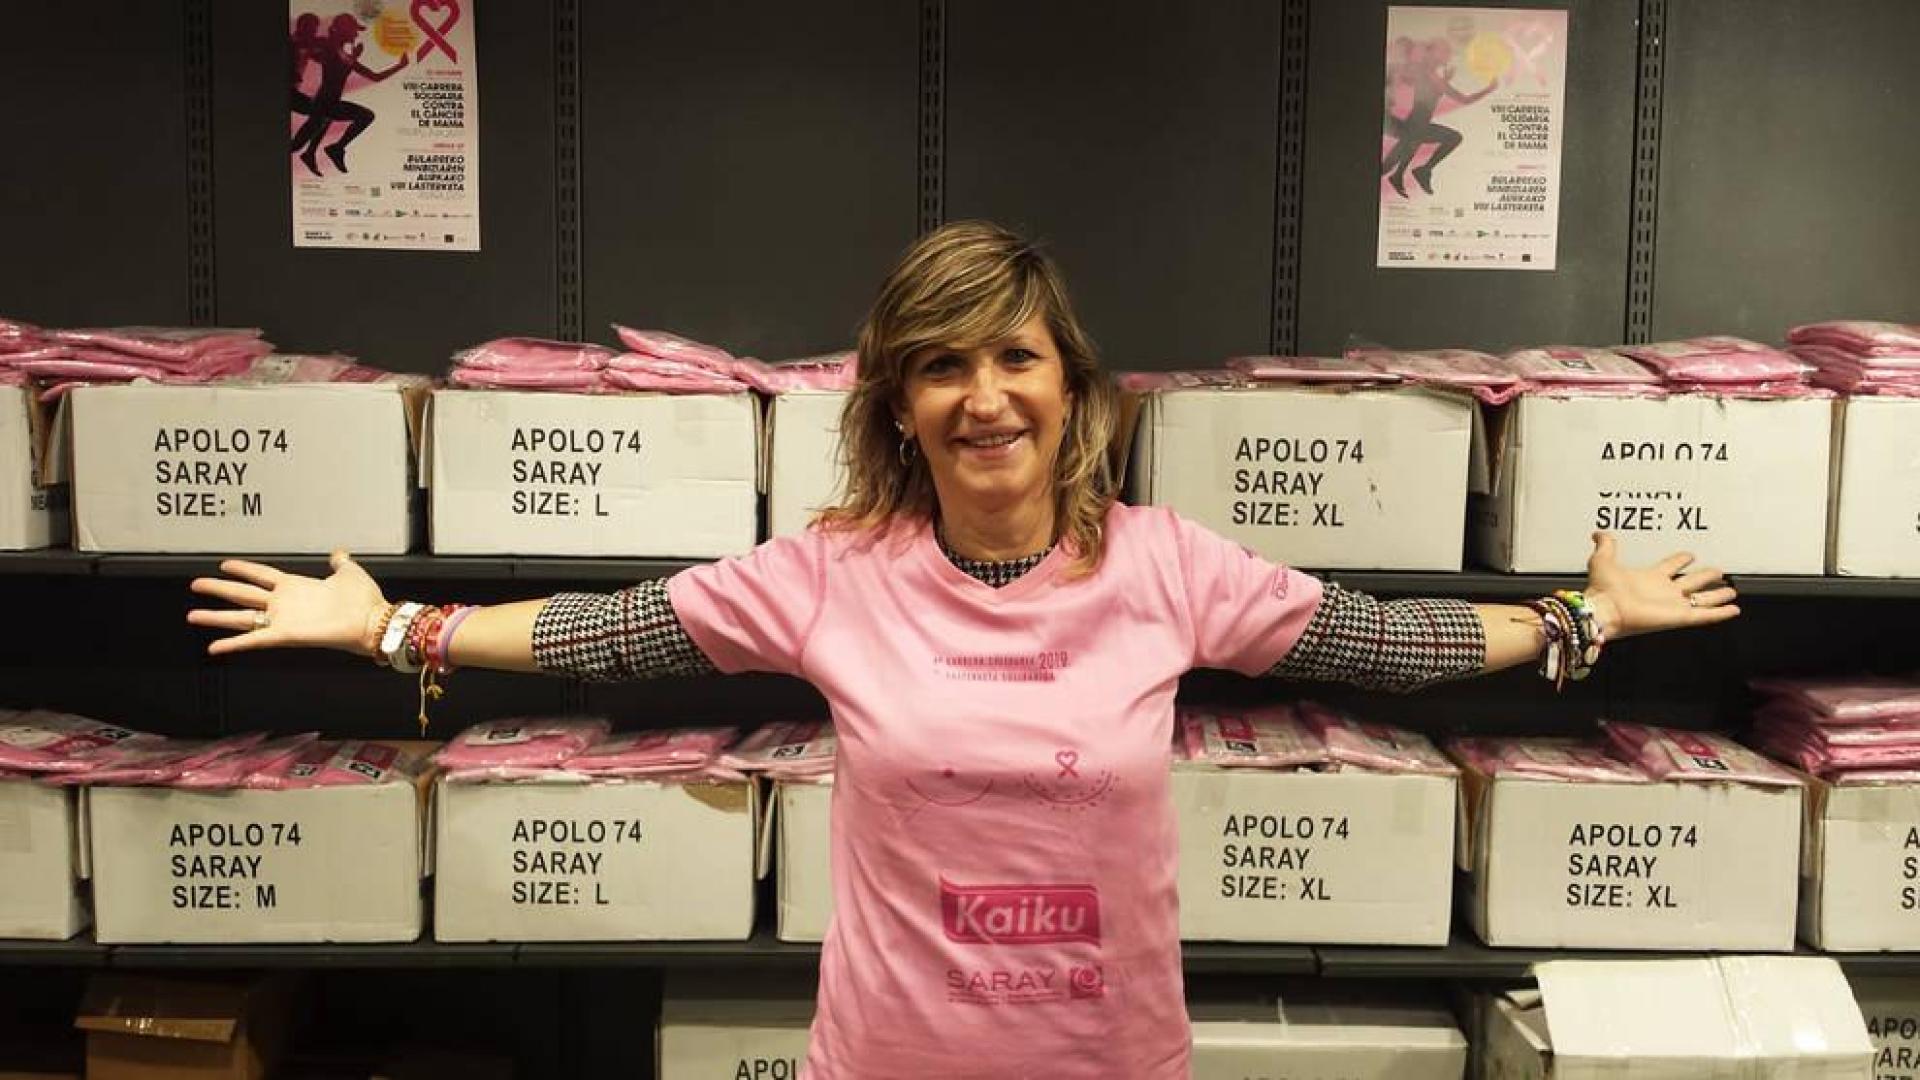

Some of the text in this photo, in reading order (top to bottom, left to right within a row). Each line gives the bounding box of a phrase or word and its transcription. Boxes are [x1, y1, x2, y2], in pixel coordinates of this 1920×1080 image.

[413, 92, 464, 100] SOLIDARIA
[420, 83, 464, 91] CARRERA
[411, 109, 420, 118] EL
[423, 101, 464, 109] CONTRA
[1507, 105, 1550, 113] CARRERA
[418, 119, 464, 127] DE MAMA
[1501, 113, 1549, 122] SOLIDARIA
[1509, 123, 1548, 131] CONTRA
[1497, 132, 1507, 140] EL
[1504, 141, 1548, 149] DE MAMA
[155, 429, 287, 452] APOLO 74
[512, 428, 640, 453] APOLO 74
[1235, 438, 1364, 463] APOLO 74
[1701, 444, 1728, 460] 74
[157, 460, 247, 485] SARAY
[514, 459, 601, 485] SARAY
[1235, 469, 1323, 496] SARAY
[157, 492, 262, 516] SIZE: M
[512, 491, 609, 516] SIZE: L
[1233, 502, 1344, 526] SIZE: XL
[1596, 506, 1707, 530] SIZE: XL
[170, 823, 301, 847] APOLO 74
[512, 820, 642, 843] APOLO 74
[1224, 815, 1348, 839] APOLO 74
[1569, 824, 1697, 847] APOLO 74
[172, 855, 262, 878] SARAY
[514, 851, 602, 875] SARAY
[1224, 845, 1309, 869] SARAY
[1569, 853, 1656, 878] SARAY
[173, 884, 276, 908] SIZE: M
[512, 882, 609, 904] SIZE: L
[1222, 875, 1330, 900] SIZE: XL
[1567, 884, 1676, 907] SIZE: XL
[955, 895, 1086, 944] Kaiku
[946, 969, 1056, 992] SARAY
[1868, 1016, 1917, 1039] APO
[735, 1058, 796, 1080] APOL
